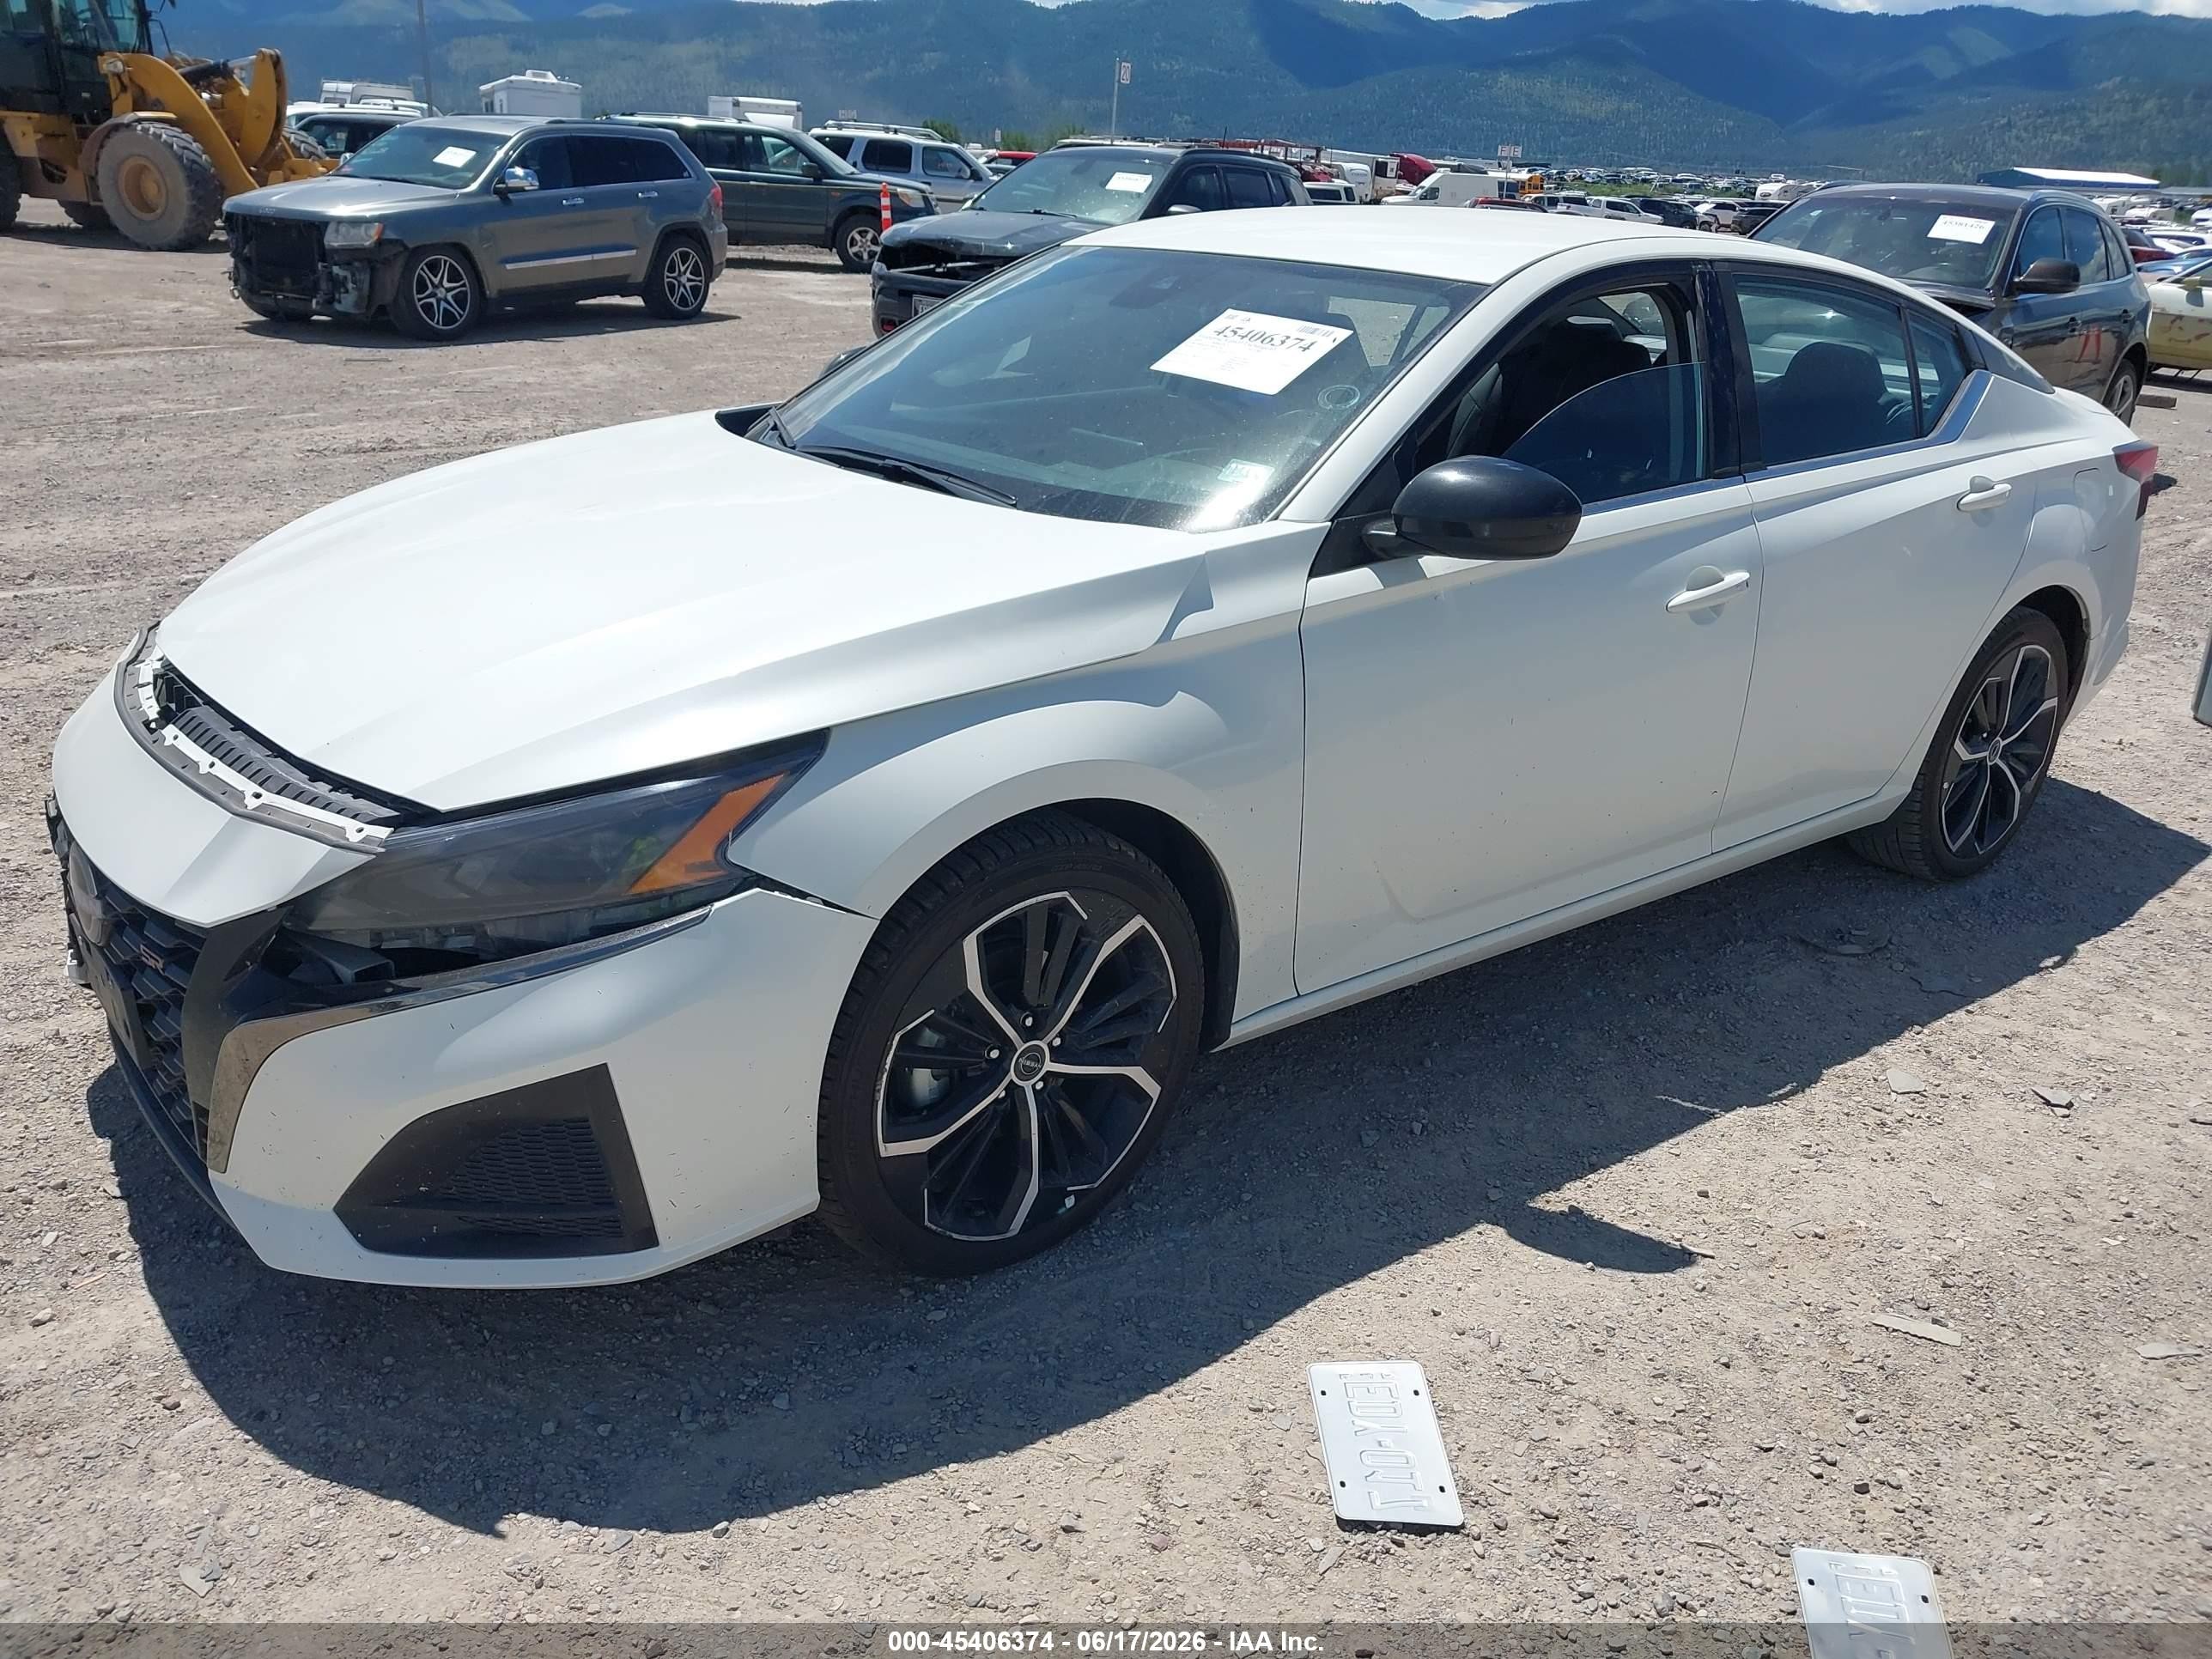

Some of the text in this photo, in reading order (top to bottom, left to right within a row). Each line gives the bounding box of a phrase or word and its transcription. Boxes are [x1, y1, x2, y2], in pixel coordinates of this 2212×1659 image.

[1213, 325, 1317, 352] 45406374
[140, 944, 166, 975] SR
[1018, 1056, 1042, 1069] NISSAN
